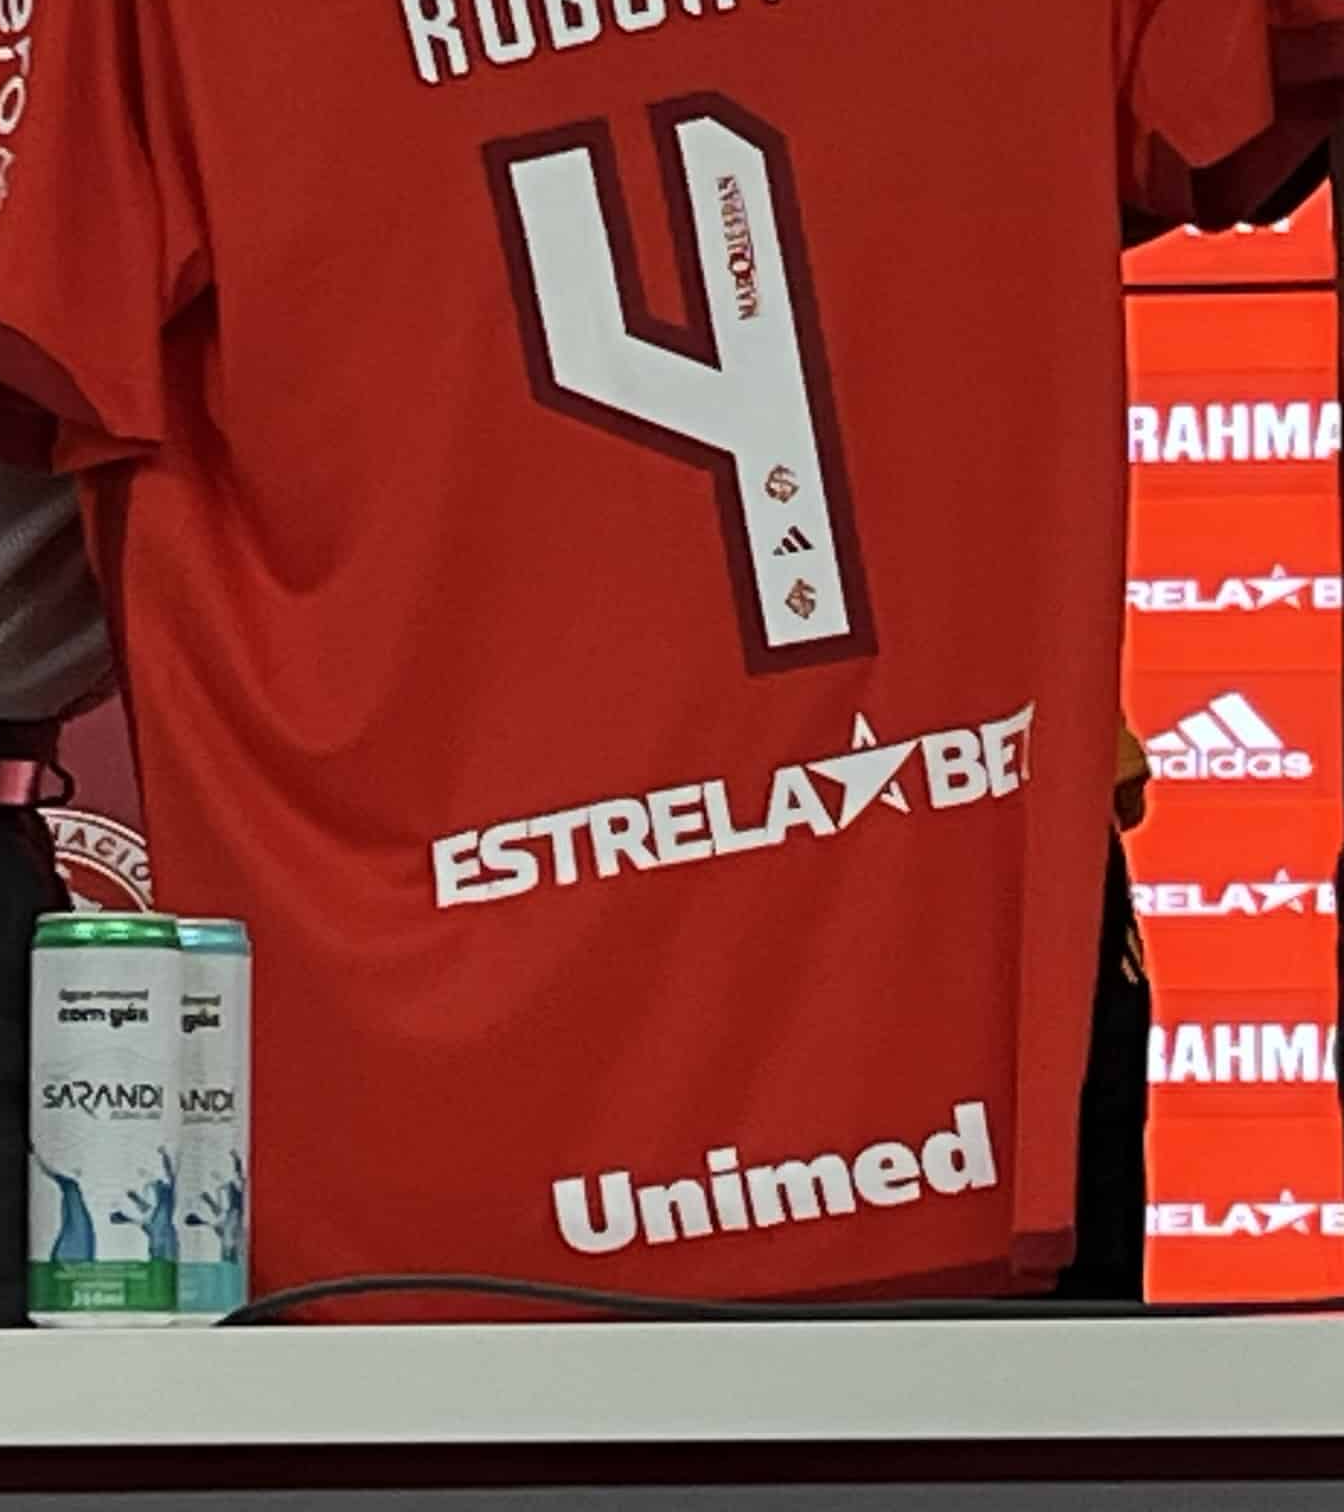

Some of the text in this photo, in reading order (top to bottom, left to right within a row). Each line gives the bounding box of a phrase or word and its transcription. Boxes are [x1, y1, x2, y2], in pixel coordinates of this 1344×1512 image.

[501, 106, 862, 656] 4
[1127, 401, 1343, 464] RAHMA
[431, 764, 839, 909] ESTRELA
[42, 1080, 164, 1119] SARANDI
[552, 1100, 999, 1255] Unimed
